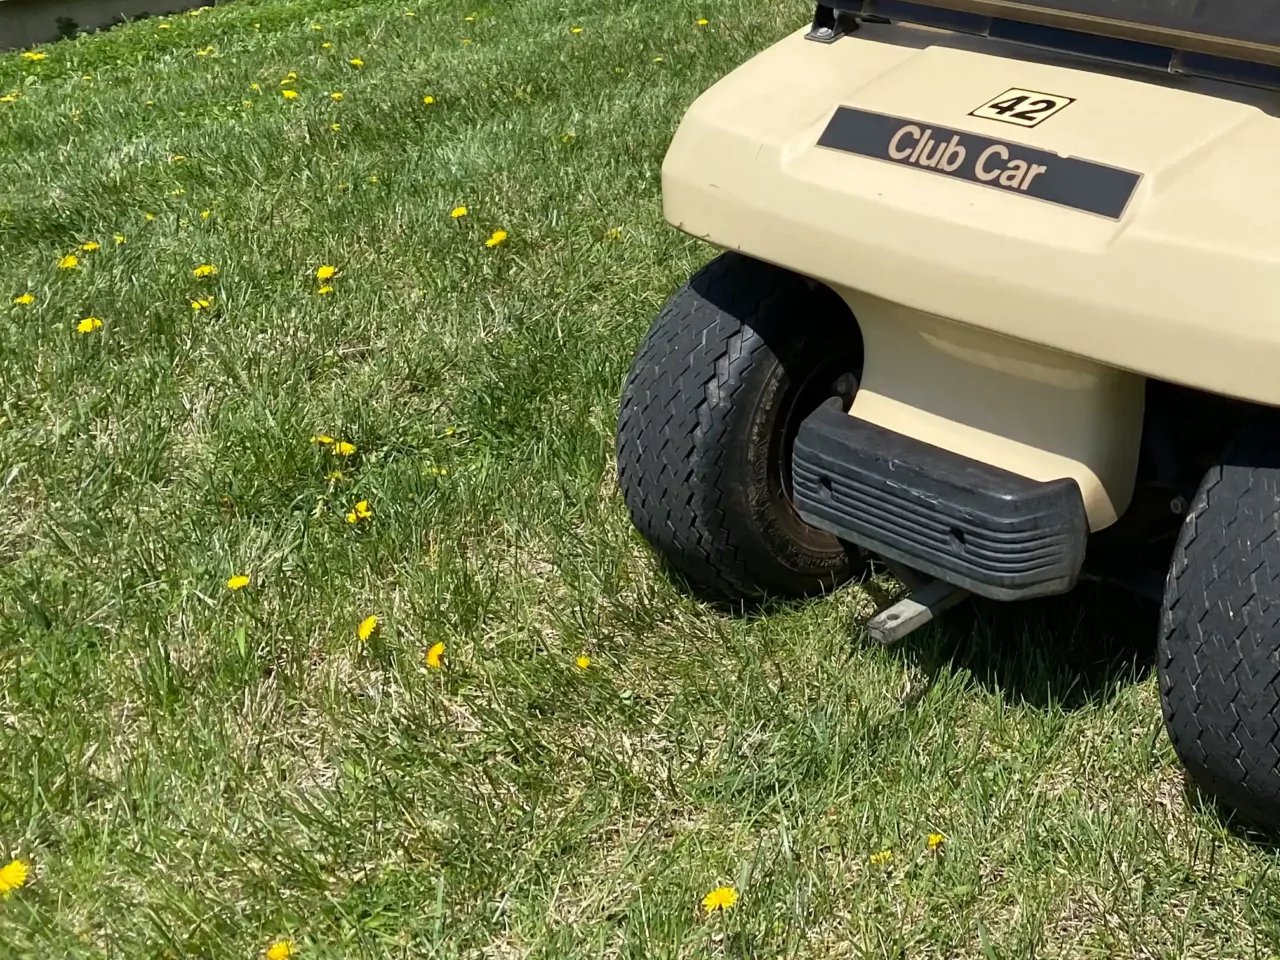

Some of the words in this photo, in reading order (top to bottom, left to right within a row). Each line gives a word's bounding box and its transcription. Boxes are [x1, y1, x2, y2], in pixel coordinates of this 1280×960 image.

[988, 95, 1057, 122] 42
[887, 125, 966, 172] Club
[974, 144, 1047, 190] Car
